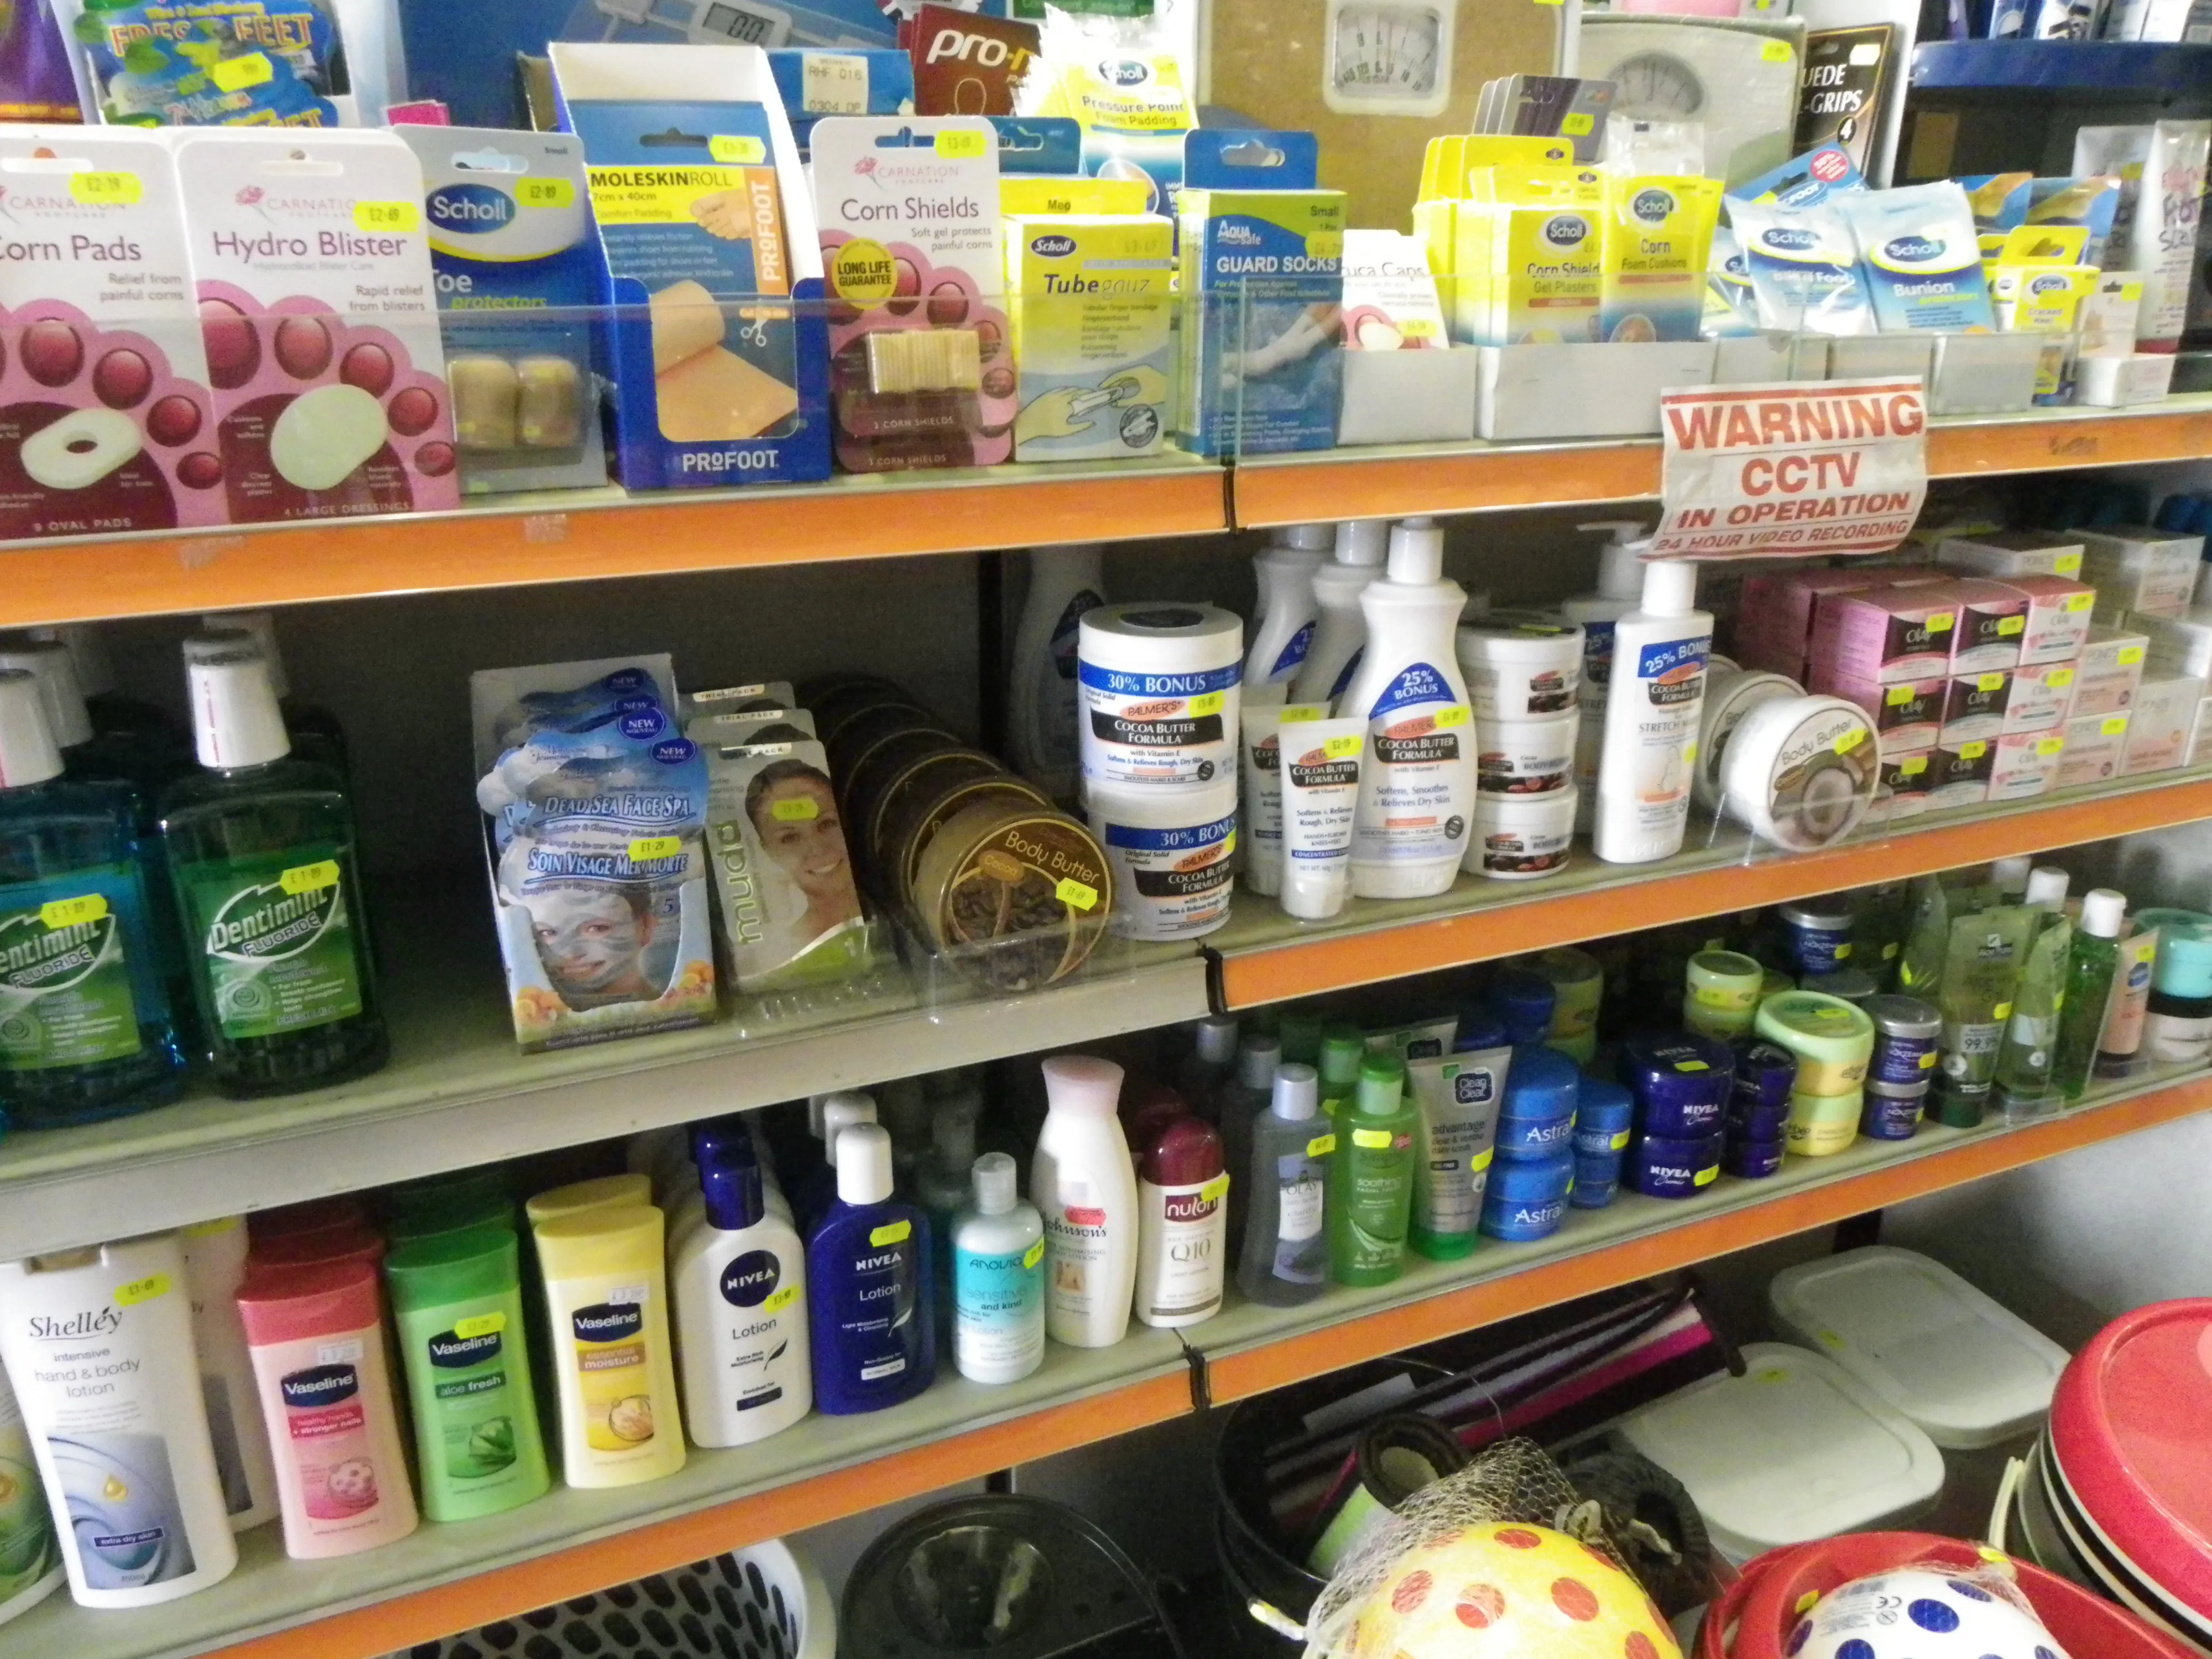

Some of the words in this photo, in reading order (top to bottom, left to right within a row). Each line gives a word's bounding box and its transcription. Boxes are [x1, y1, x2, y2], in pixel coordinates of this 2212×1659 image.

[233, 13, 314, 46] FEET
[808, 67, 831, 79] RHF
[839, 69, 863, 80] 016
[809, 101, 839, 112] 0304
[1082, 95, 1144, 113] Pressure
[1129, 115, 1177, 127] Padding
[1840, 117, 1852, 138] 4
[590, 171, 733, 187] MOLESKINROLL
[878, 165, 959, 178] CARNATION
[593, 193, 615, 202] 7cm
[627, 192, 657, 201] 40cm
[434, 195, 507, 223] Scholl
[841, 198, 899, 221] Corn
[905, 196, 979, 221] Shields
[1310, 205, 1340, 217] Small
[1637, 197, 1671, 215] Scholl
[911, 227, 930, 237] Soft
[934, 227, 948, 239] gel
[951, 226, 992, 238] protects
[1550, 223, 1582, 238] Scholl
[71, 234, 142, 261] Pads
[213, 231, 307, 264] Hydro
[319, 231, 408, 257] Blister
[931, 240, 963, 253] painful
[966, 241, 993, 249] corns
[1035, 239, 1071, 252] Scholl
[1641, 239, 1671, 254] Corn
[1889, 241, 1942, 257] Scholl
[837, 262, 866, 275] LONG
[869, 260, 891, 273] LIFE
[1216, 255, 1278, 273] GUARD
[1282, 256, 1337, 273] SOCKS
[1621, 258, 1646, 270] Foam
[1648, 257, 1687, 270] Cushions
[108, 273, 145, 286] Relief
[150, 273, 182, 285] from
[1381, 262, 1426, 282] Caps
[839, 274, 892, 286] GUARANTEE
[1534, 281, 1551, 293] Gel
[1555, 281, 1597, 293] Plasters
[100, 288, 146, 304] painful
[148, 290, 184, 302] corns
[355, 285, 388, 299] Rapid
[392, 284, 424, 296] relief
[1892, 280, 1955, 297] Bunion
[349, 300, 379, 312] from
[382, 299, 426, 312] blisters
[883, 418, 911, 429] CORN
[915, 416, 953, 427] SHIELDS
[1667, 394, 1923, 451] WARNING
[909, 454, 947, 464] SHIELDS
[1740, 451, 1861, 497] CCTV
[295, 505, 336, 516] LARGE
[341, 502, 410, 514] DRESSINGS
[1676, 507, 1717, 529] IN
[1726, 492, 1911, 526] OPERATION
[93, 517, 133, 529] PADS
[1655, 539, 1682, 551] 24
[1688, 533, 1744, 550] HOUR
[1749, 528, 1803, 545] VIDEO
[1808, 520, 1910, 541] RECORDING
[1645, 651, 1677, 674] 25%
[612, 675, 637, 685] NEW
[1107, 672, 1140, 692] 30%
[1145, 674, 1206, 693] BONUS
[1401, 670, 1434, 687] 25%
[700, 691, 728, 700] TRIAL
[731, 687, 757, 696] PACK
[1394, 684, 1439, 700] BONUS
[1651, 685, 1680, 693] COCOA
[623, 701, 649, 709] NEW
[750, 711, 775, 719] PACK
[628, 718, 656, 729] NEW
[1114, 719, 1154, 733] COCOA
[1156, 722, 1196, 733] BUTTER
[1639, 720, 1679, 733] STRETCH
[1128, 733, 1182, 744] FORMULA
[1378, 738, 1420, 750] COCOA
[1421, 737, 1455, 748] BUTTER
[1781, 741, 1814, 765] Body
[1816, 718, 1853, 745] Butter
[660, 747, 687, 755] NEW
[758, 746, 784, 754] PACK
[1147, 749, 1175, 757] Vitamin
[1392, 749, 1443, 760] FORMULA
[1133, 756, 1157, 766] Relieves
[1292, 766, 1326, 776] COCOA
[1326, 764, 1357, 774] BUTTER
[1305, 774, 1346, 784] FORMULA
[1376, 785, 1408, 796] Softens,
[1411, 784, 1449, 794] Smoothes
[543, 796, 587, 814] DEAD
[587, 794, 619, 815] SEA
[621, 793, 661, 816] FACE
[663, 794, 690, 817] SPA
[1381, 797, 1416, 807] Relieves
[1418, 796, 1432, 808] Dry
[1434, 795, 1451, 804] Skin
[1296, 808, 1322, 817] Softens
[1299, 817, 1324, 827] Rough,
[1325, 817, 1338, 826] Dry
[1160, 831, 1194, 847] 30%
[527, 847, 562, 873] SOIN
[564, 851, 613, 875] VISAGE
[983, 854, 1019, 875] Cocoa
[1004, 830, 1050, 867] Body
[1050, 849, 1100, 884] Butter
[1168, 873, 1205, 885] COCOA
[1206, 860, 1230, 879] BUTTER
[1182, 877, 1224, 893] FORMULA
[242, 910, 323, 957] FLUORIDE
[9, 943, 95, 988] FLUORIDE
[1683, 1104, 1719, 1115] NIVEA
[1432, 1120, 1485, 1135] advantage
[1526, 1123, 1572, 1142] Astral
[1650, 1165, 1691, 1178] NIVEA
[1514, 1201, 1563, 1224] Astral
[1170, 1238, 1212, 1262] Q10
[855, 1251, 902, 1271] NIVEA
[727, 1269, 775, 1290] NIVEA
[859, 1282, 902, 1302] Lotion
[966, 1284, 1027, 1300] sensitive
[980, 1303, 999, 1311] and
[1001, 1299, 1022, 1311] kind
[29, 1305, 124, 1337] Shelley
[575, 1312, 639, 1330] Vaseline
[732, 1318, 778, 1341] Lotion
[973, 1327, 1004, 1335] Lotion
[431, 1333, 498, 1357] Vaseline
[586, 1345, 637, 1360] essential
[54, 1346, 111, 1363] intensive
[584, 1354, 640, 1370] moisture
[34, 1368, 78, 1384] hand
[81, 1369, 92, 1380] &
[95, 1357, 141, 1379] body
[66, 1381, 116, 1399] lotion
[284, 1374, 354, 1396] Vaseline
[440, 1385, 466, 1397] aloe
[467, 1375, 502, 1391] fresh
[300, 1422, 338, 1435] stronger
[340, 1416, 362, 1427] nails
[101, 1536, 121, 1546] extra
[123, 1535, 137, 1545] dry
